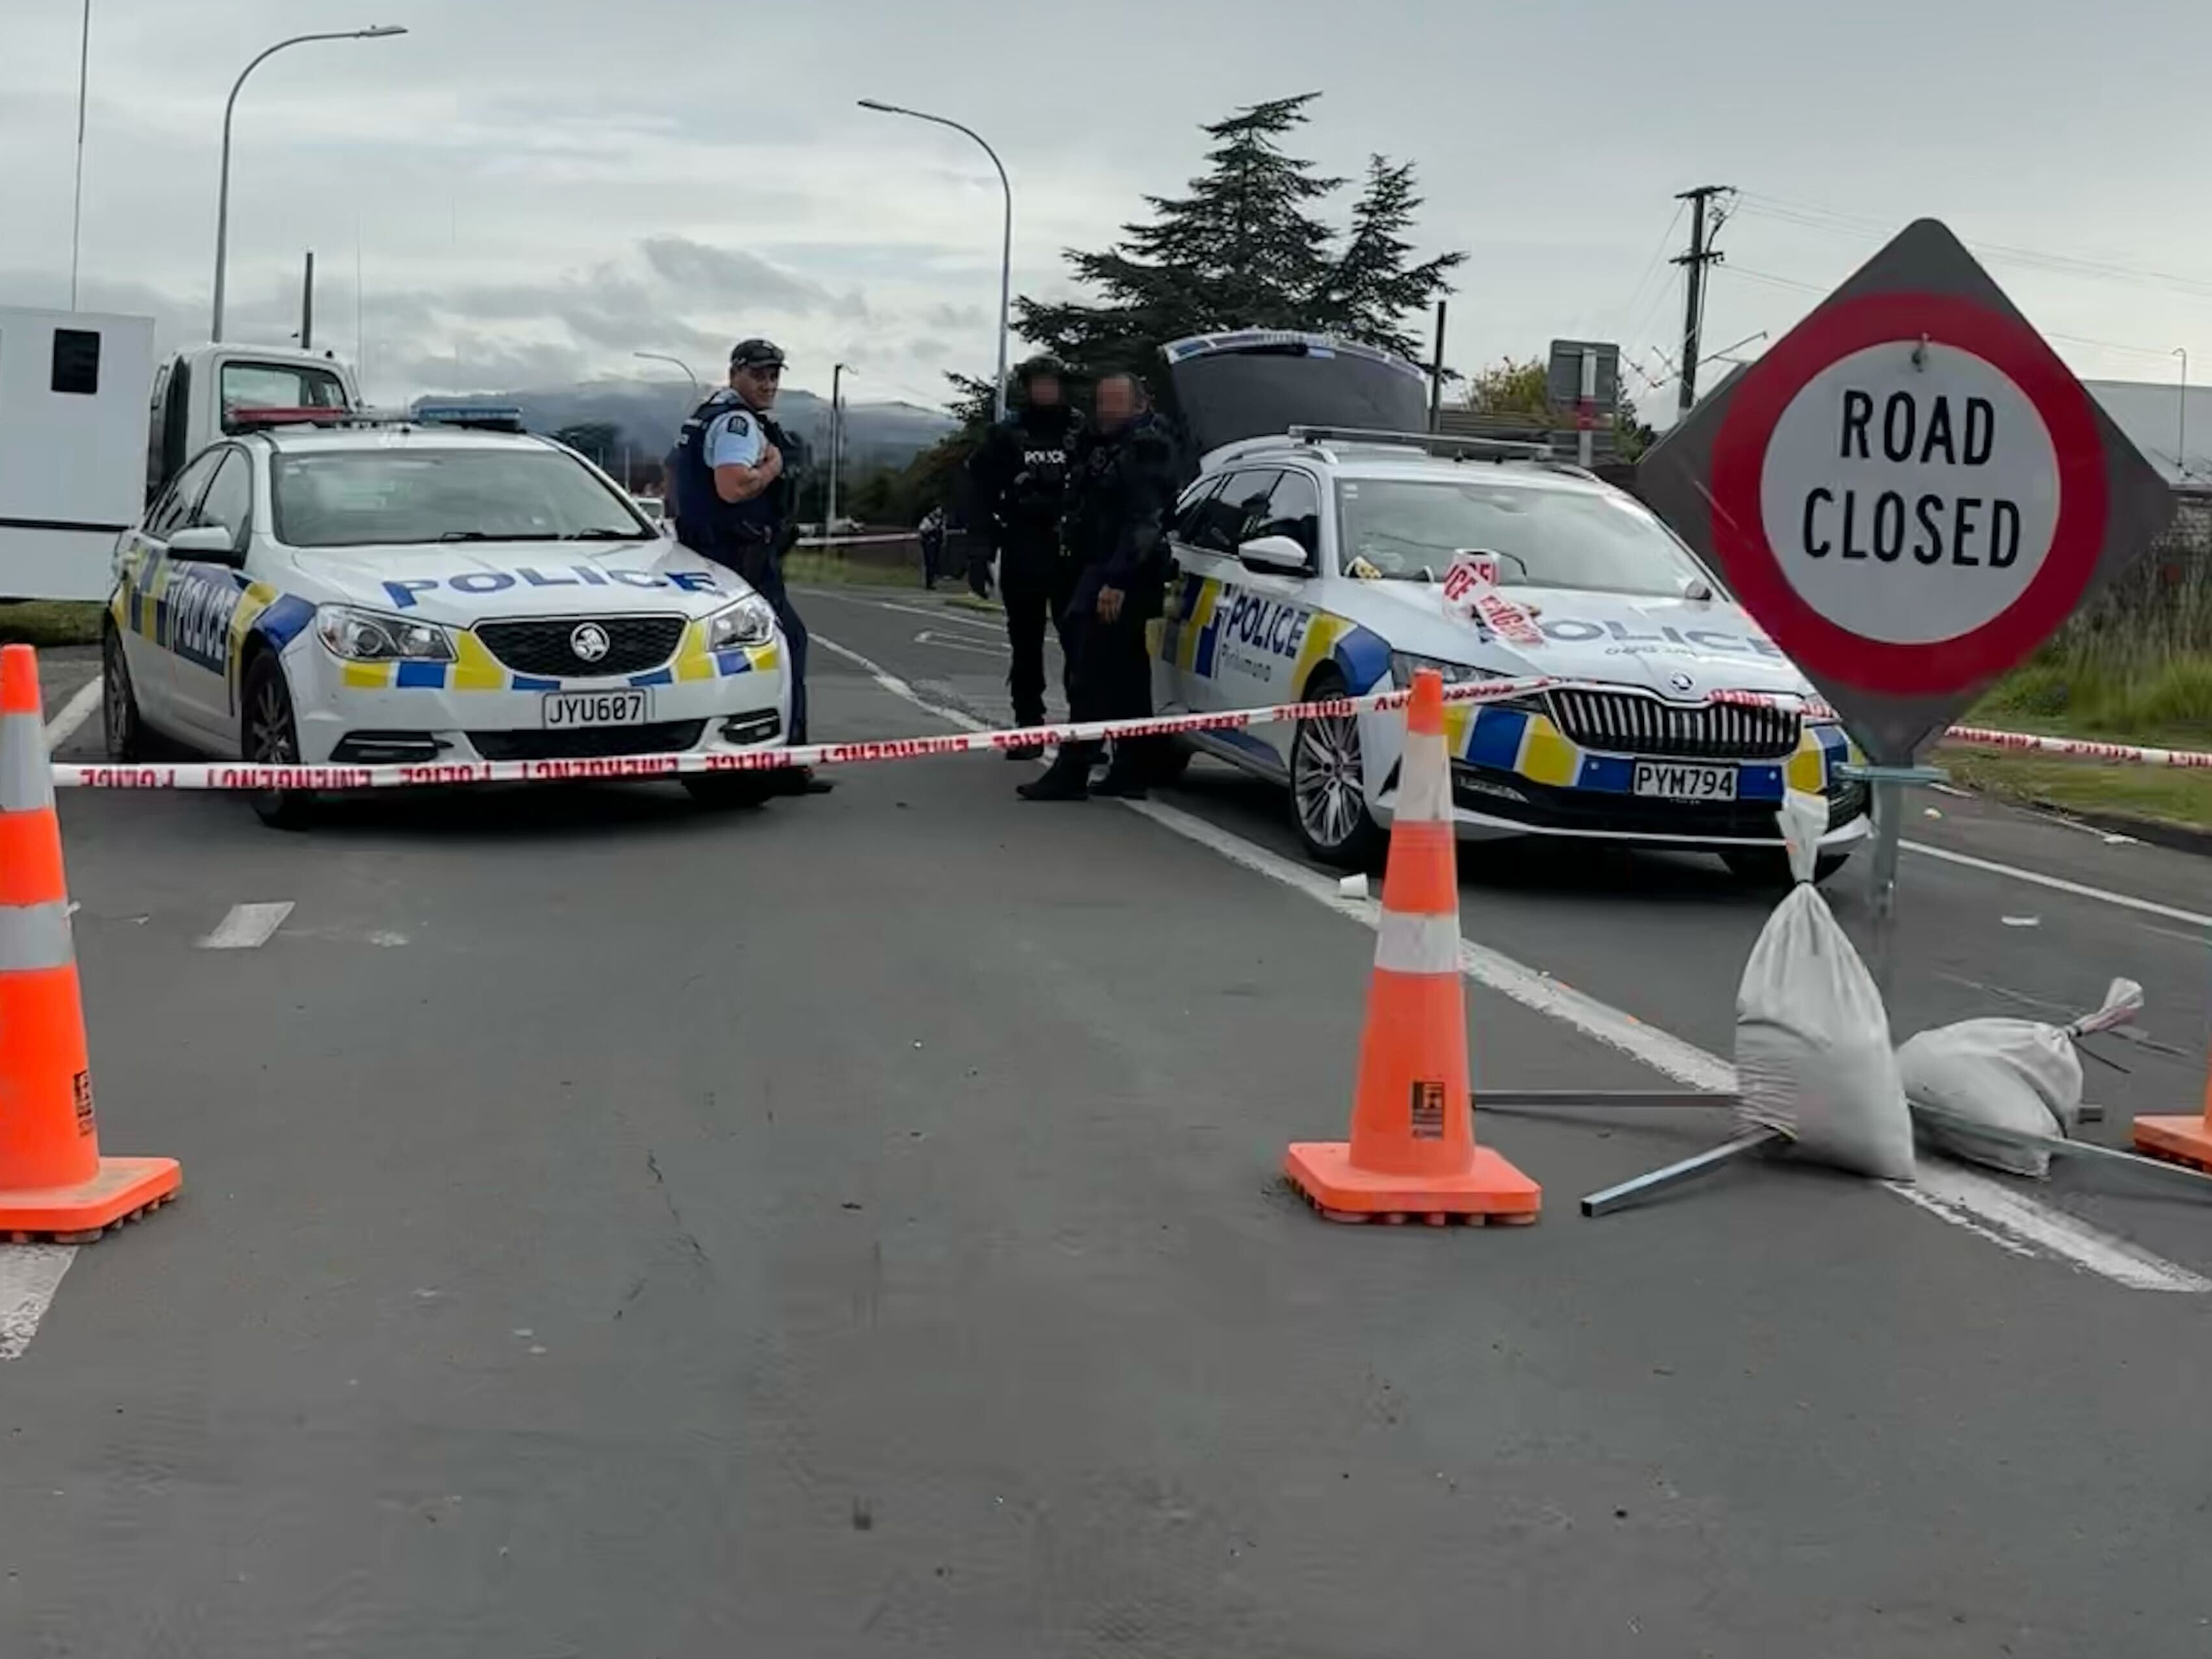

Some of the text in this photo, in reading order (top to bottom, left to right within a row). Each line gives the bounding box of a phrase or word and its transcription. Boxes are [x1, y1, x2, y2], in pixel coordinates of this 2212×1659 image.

[1840, 390, 1994, 465] ROAD
[1024, 450, 1067, 464] POLICE
[1803, 487, 2020, 568] CLOSED
[382, 565, 728, 609] POLICE
[173, 573, 240, 662] POLICE
[1226, 595, 1309, 660] POLICE
[549, 695, 641, 723] JYU607
[1638, 766, 1734, 797] PYM794
